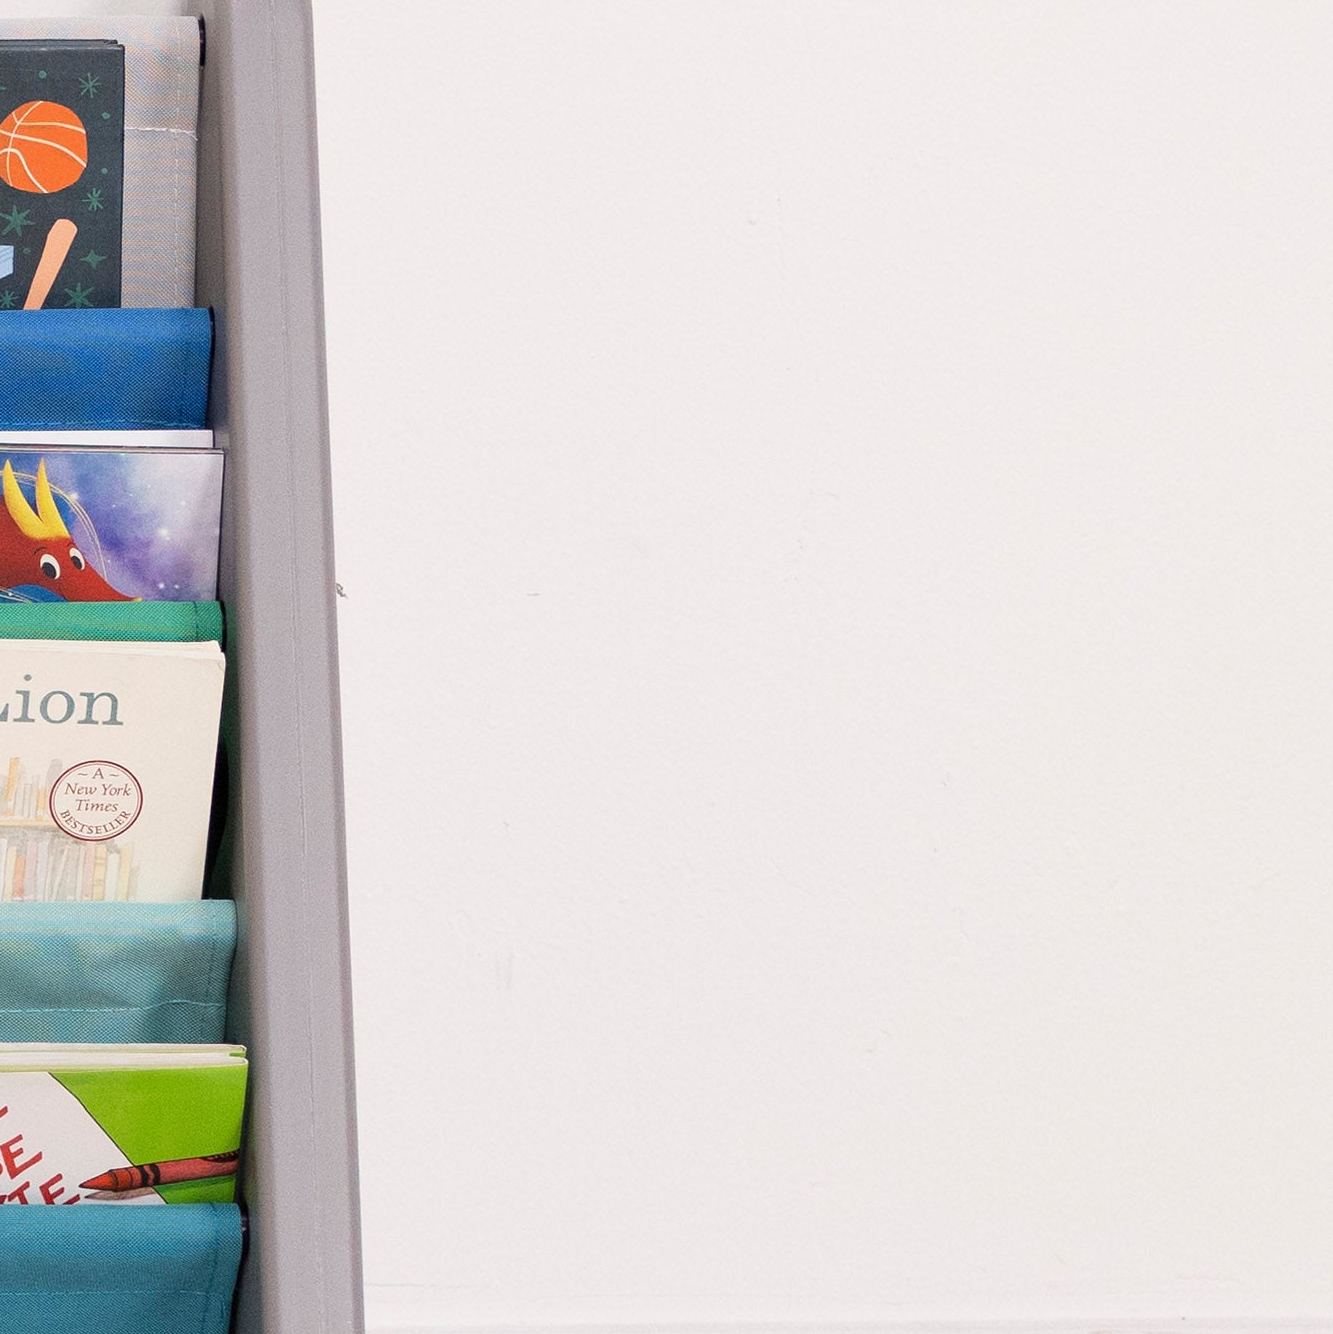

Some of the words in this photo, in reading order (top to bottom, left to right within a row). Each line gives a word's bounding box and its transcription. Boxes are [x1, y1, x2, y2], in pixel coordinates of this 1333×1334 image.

[92, 767, 104, 779] A
[64, 782, 97, 795] New
[102, 783, 132, 796] York
[75, 798, 119, 812] Times
[60, 809, 131, 834] BESTSELLER
